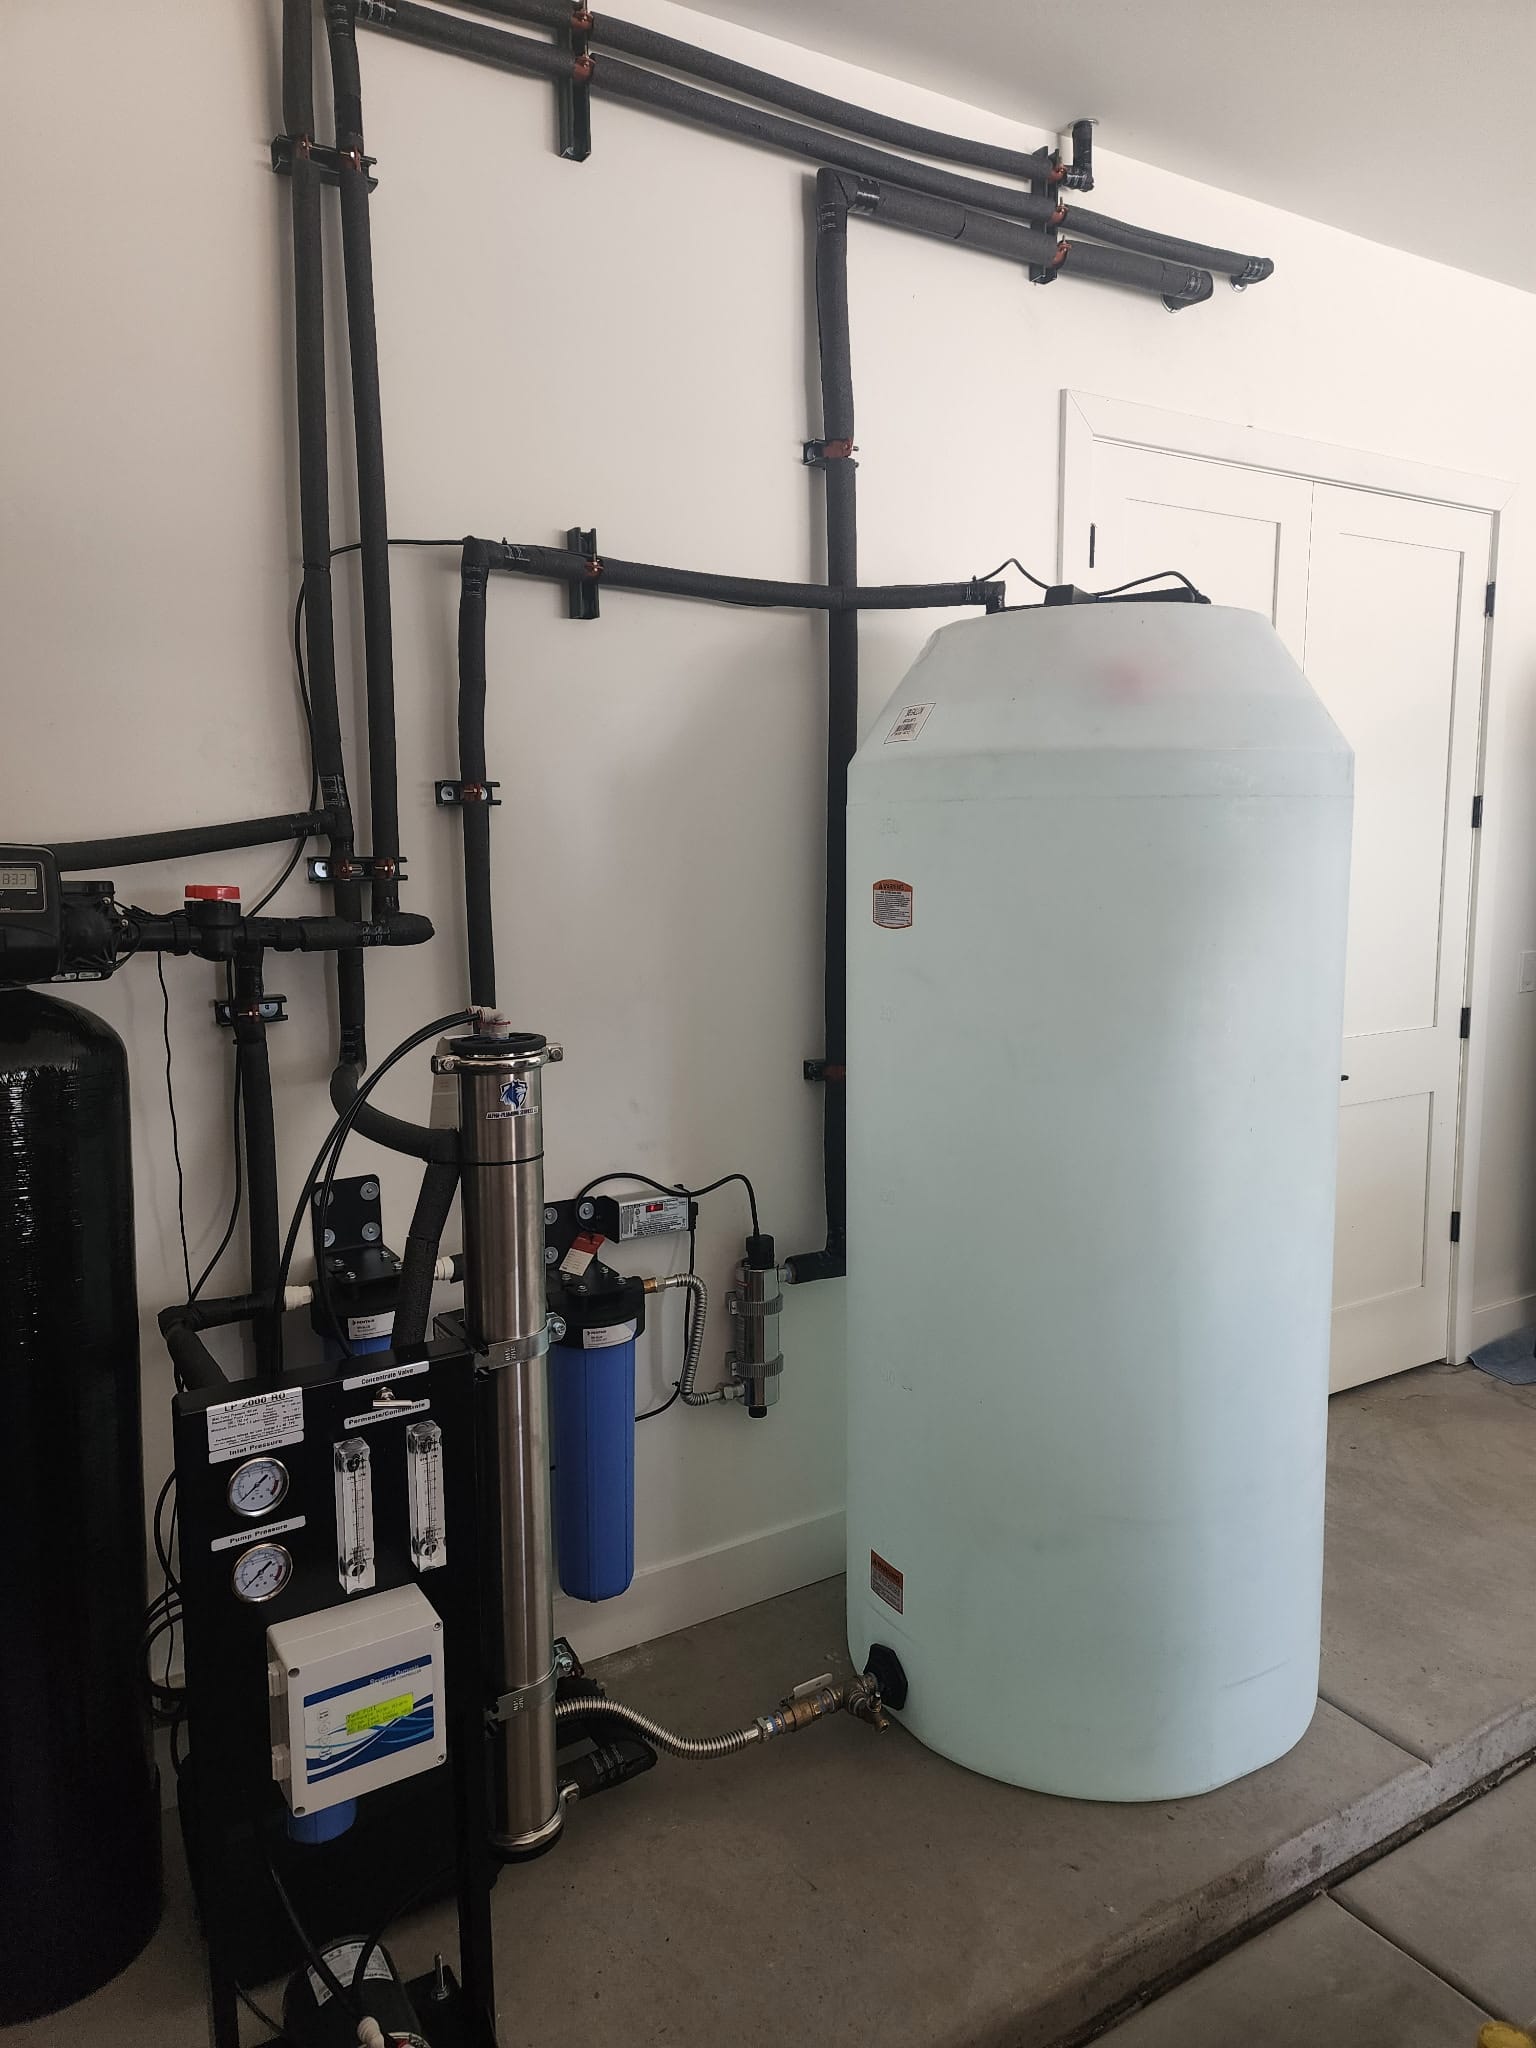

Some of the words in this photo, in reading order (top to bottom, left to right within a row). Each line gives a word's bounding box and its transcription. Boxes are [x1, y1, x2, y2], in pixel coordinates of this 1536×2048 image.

[361, 1372, 396, 1385] Concentrate
[397, 1368, 414, 1376] Valve
[242, 1396, 267, 1408] 2000
[229, 1447, 247, 1456] Inlet
[249, 1439, 283, 1451] Pressure
[229, 1532, 252, 1544] Pump
[254, 1523, 288, 1537] Pressure
